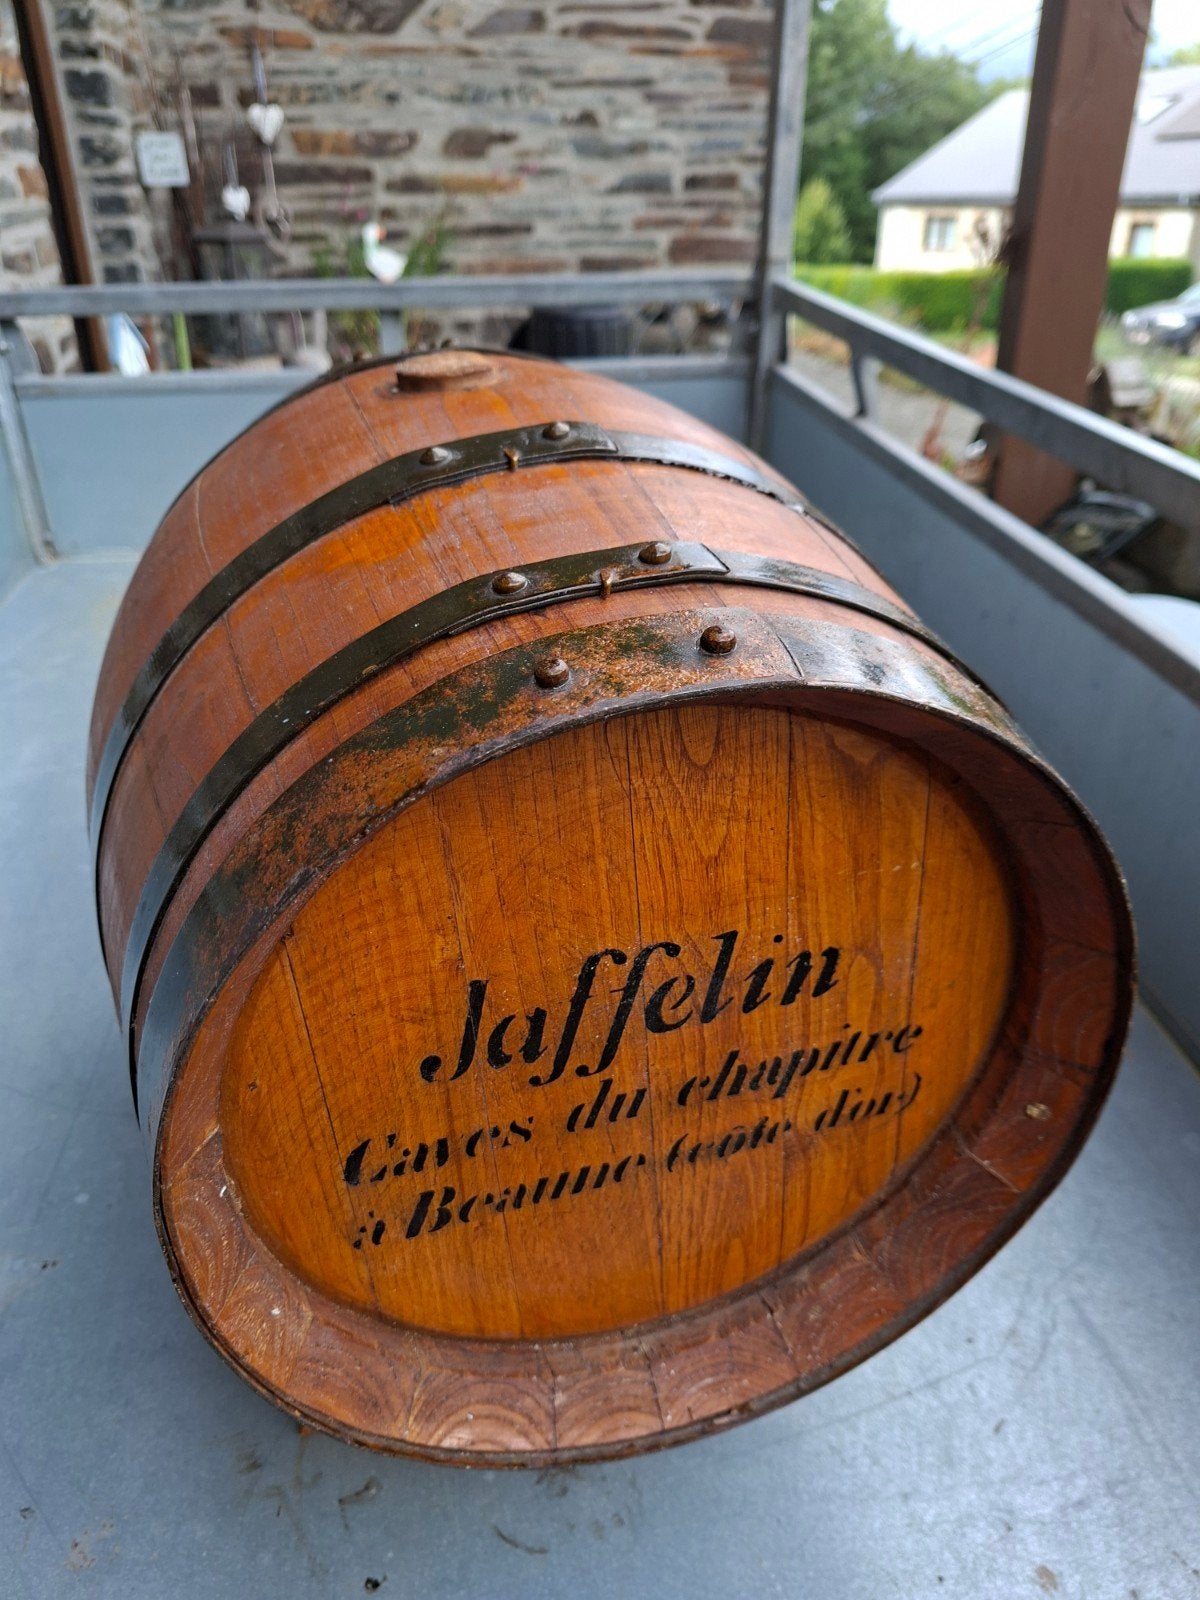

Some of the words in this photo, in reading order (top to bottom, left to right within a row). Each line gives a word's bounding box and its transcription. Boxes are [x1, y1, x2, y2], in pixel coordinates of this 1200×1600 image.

[420, 929, 841, 1086] Jaffelin
[344, 1116, 534, 1186] Caves
[567, 1078, 648, 1132] du
[677, 1024, 923, 1106] chapitre
[406, 1153, 647, 1240] Beaune
